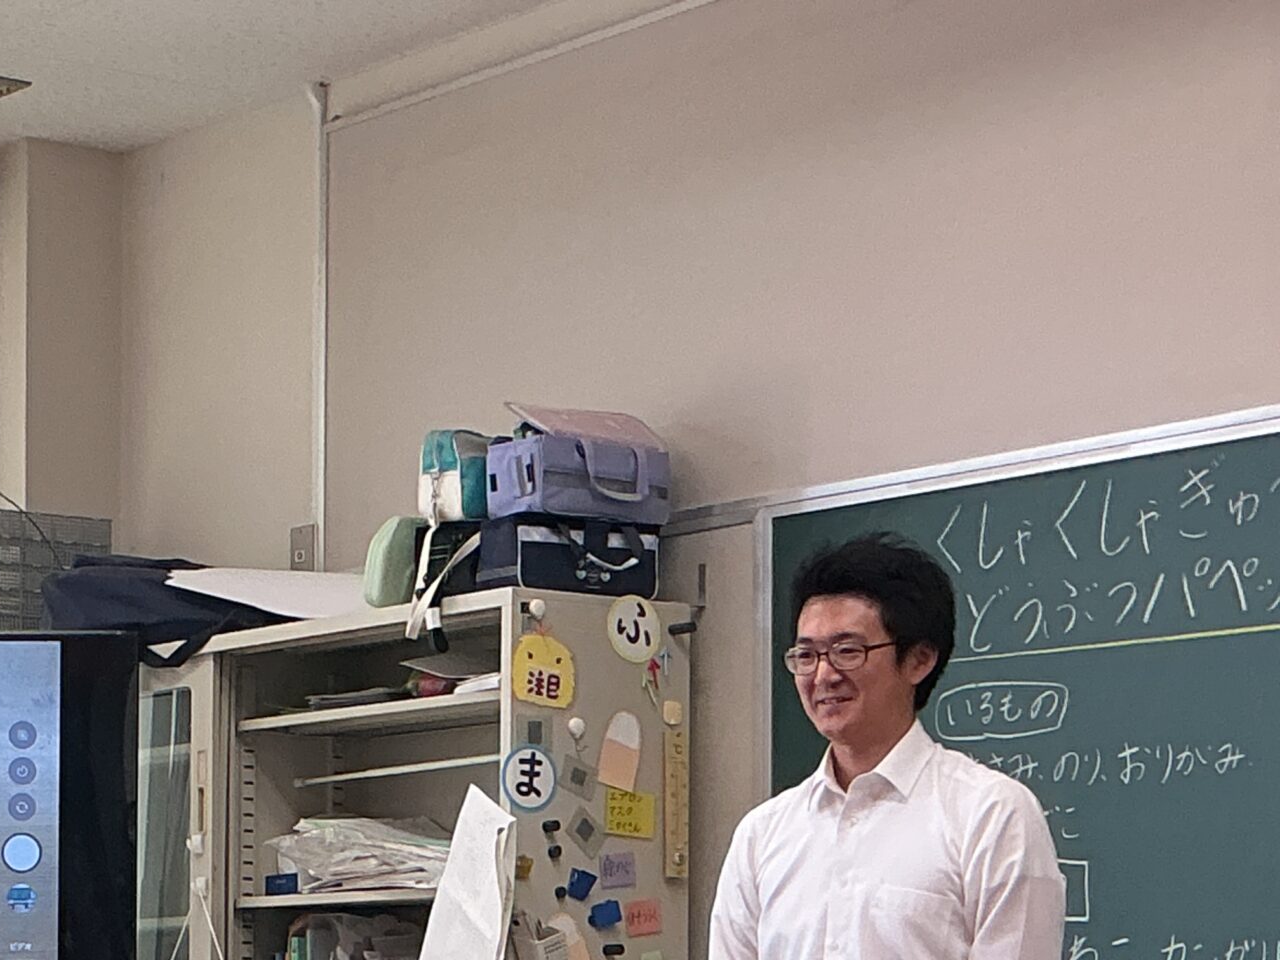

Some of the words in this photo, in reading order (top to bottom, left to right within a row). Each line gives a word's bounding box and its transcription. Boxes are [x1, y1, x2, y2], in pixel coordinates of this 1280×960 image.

[936, 452, 1280, 574] くしゃくしゃぎゅ
[616, 601, 652, 647] ふ
[946, 689, 1059, 726] いるもの
[515, 751, 544, 798] ま
